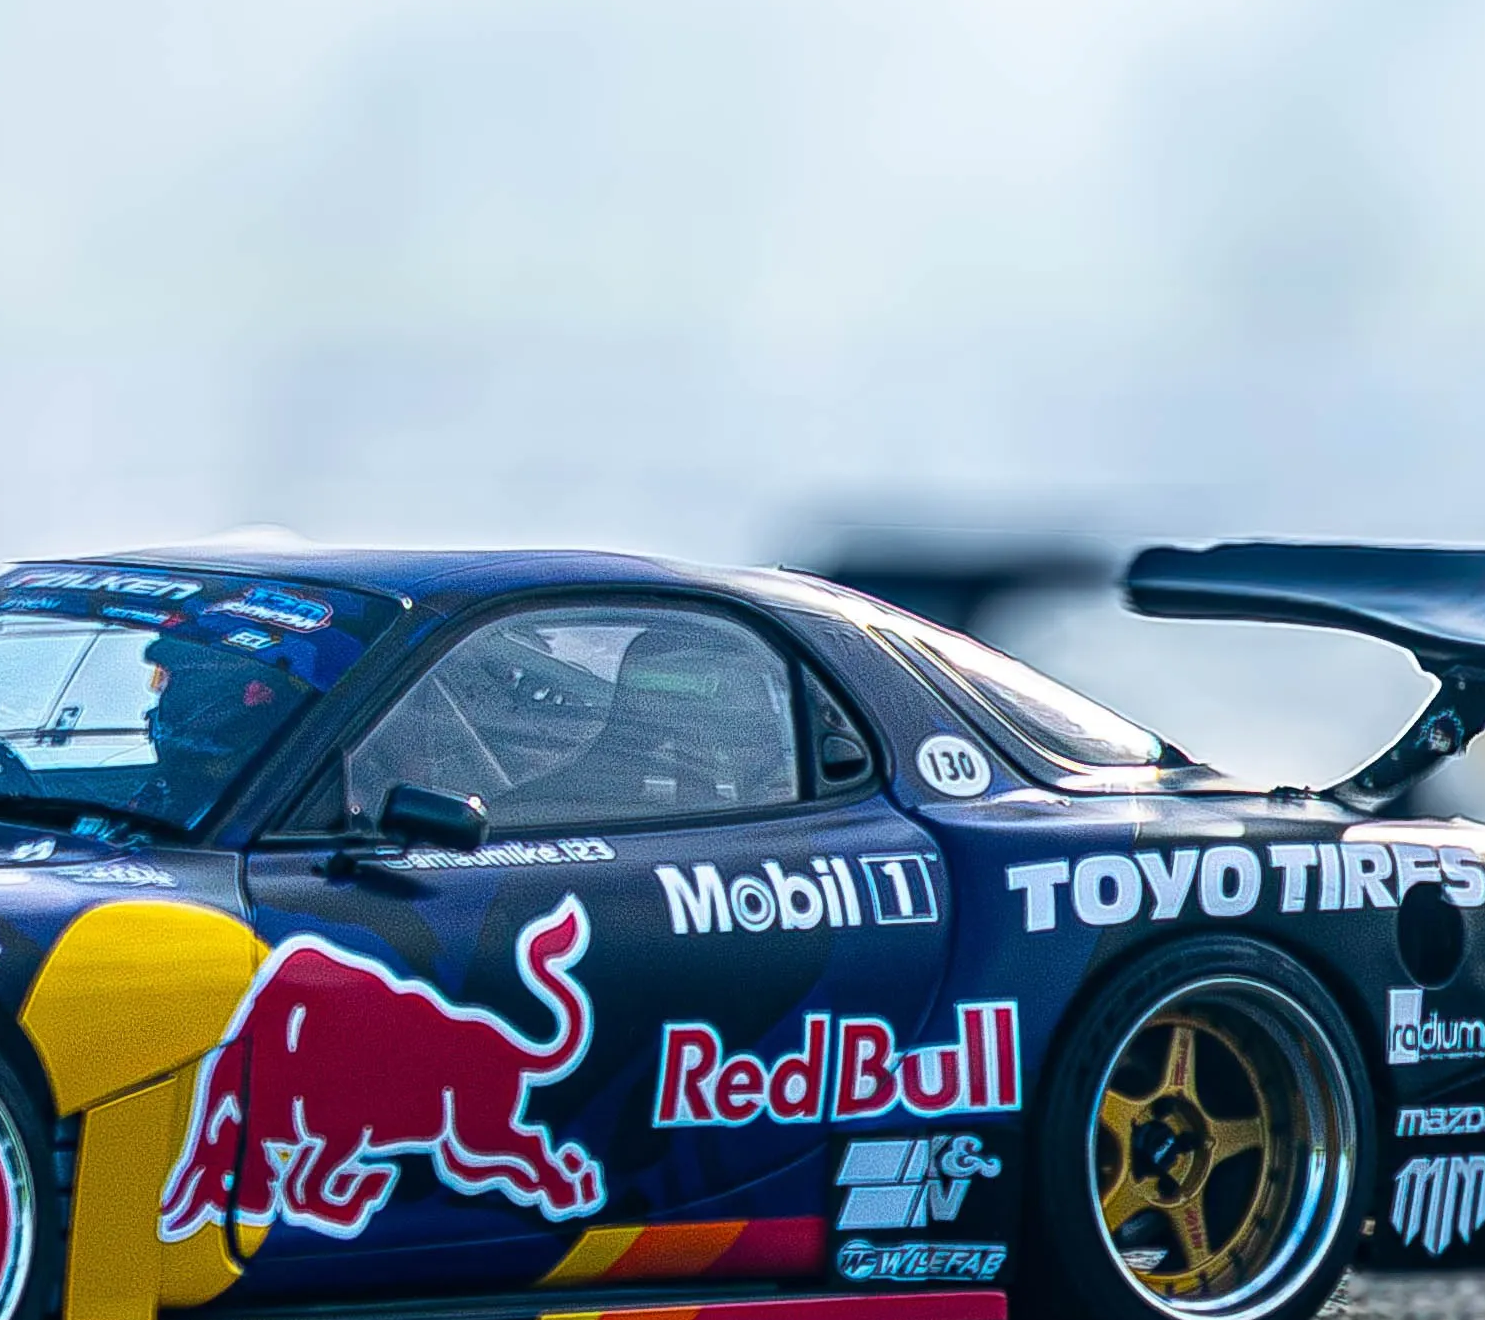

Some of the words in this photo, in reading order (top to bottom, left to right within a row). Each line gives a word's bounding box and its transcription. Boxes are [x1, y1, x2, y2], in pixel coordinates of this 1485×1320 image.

[927, 750, 977, 783] 130
[654, 855, 862, 934] Mobil
[1006, 845, 1262, 933] TOYO
[653, 1014, 830, 1128] Red
[831, 1001, 1021, 1122] Bull
[878, 1248, 1008, 1277] WISEFAB
